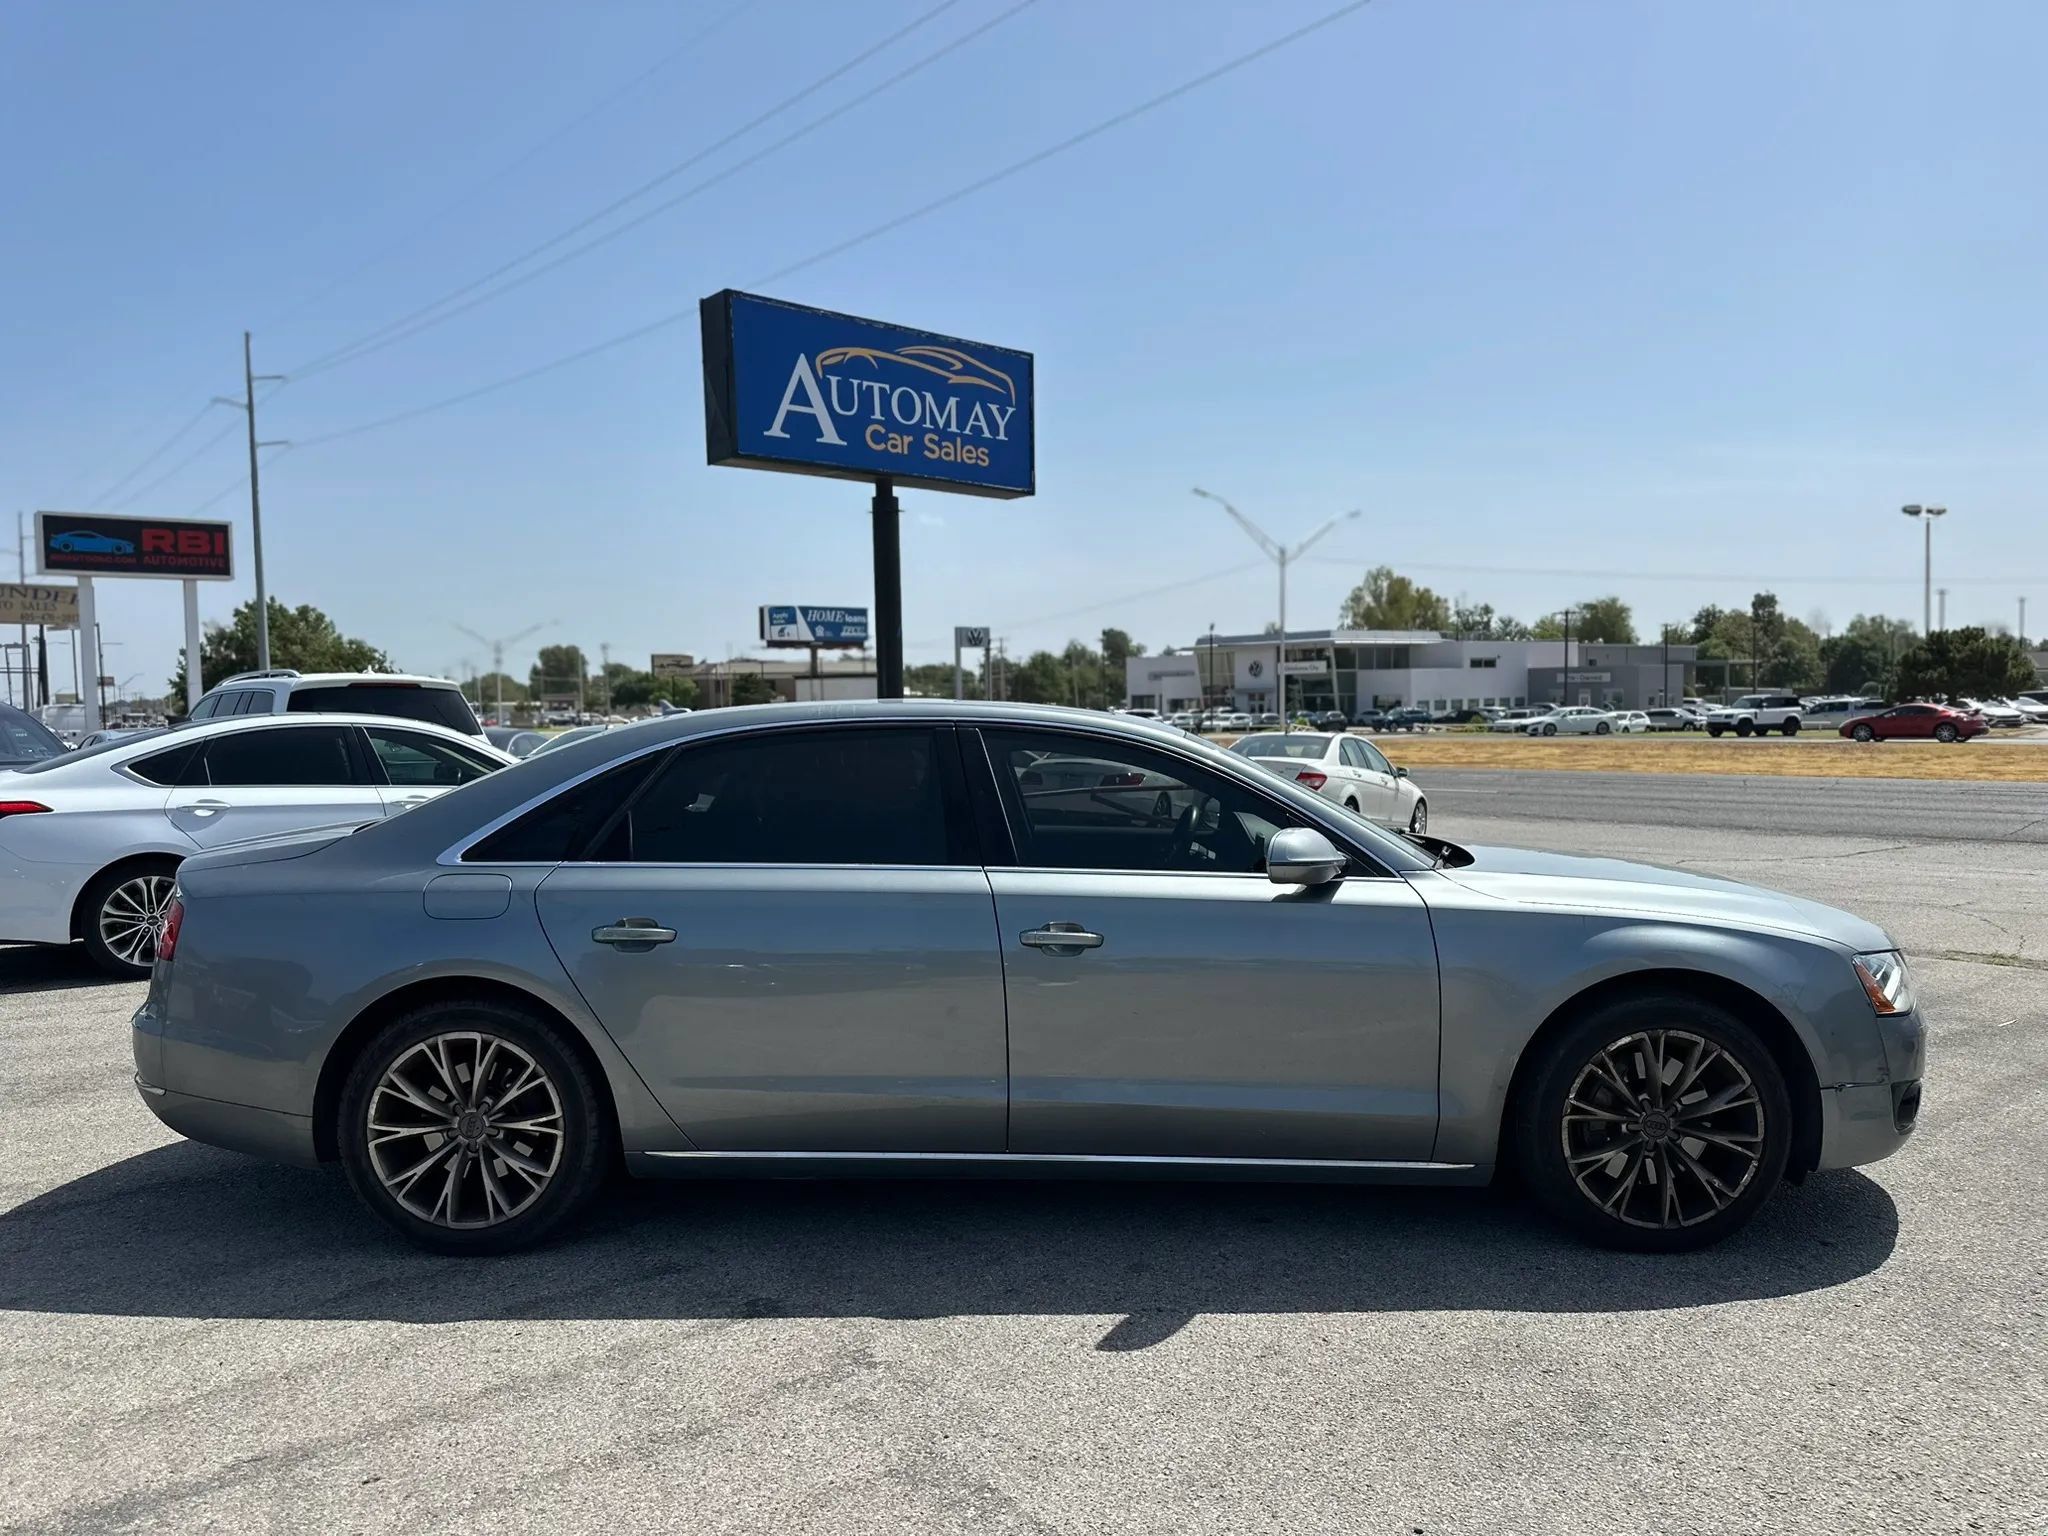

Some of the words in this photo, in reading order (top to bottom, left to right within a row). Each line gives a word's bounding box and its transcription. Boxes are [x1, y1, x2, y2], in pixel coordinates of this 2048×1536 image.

[763, 352, 1016, 446] AUTOMAY
[865, 423, 914, 455] Car
[923, 433, 990, 468] Sales
[142, 528, 225, 555] RBI
[143, 555, 225, 568] AUTOMOTIVE
[807, 609, 845, 623] HOME
